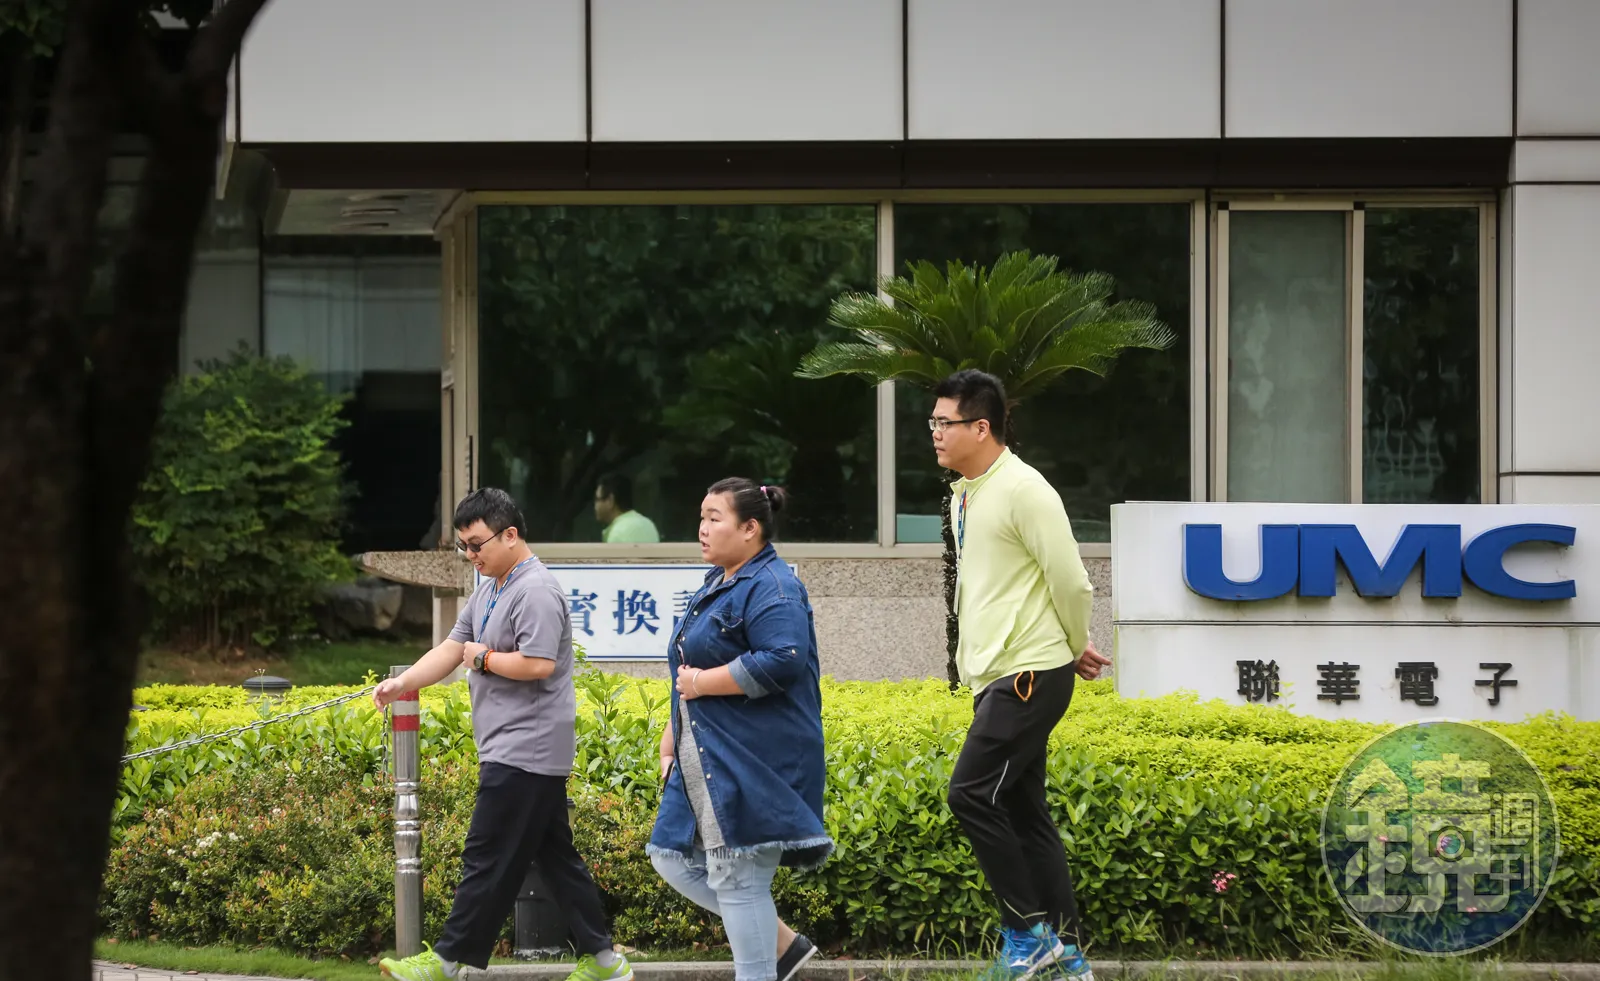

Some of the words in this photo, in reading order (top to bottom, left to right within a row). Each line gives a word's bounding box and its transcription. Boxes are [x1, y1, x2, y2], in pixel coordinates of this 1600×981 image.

[1183, 523, 1577, 599] UMC
[1236, 659, 1518, 706] 聯華電子
